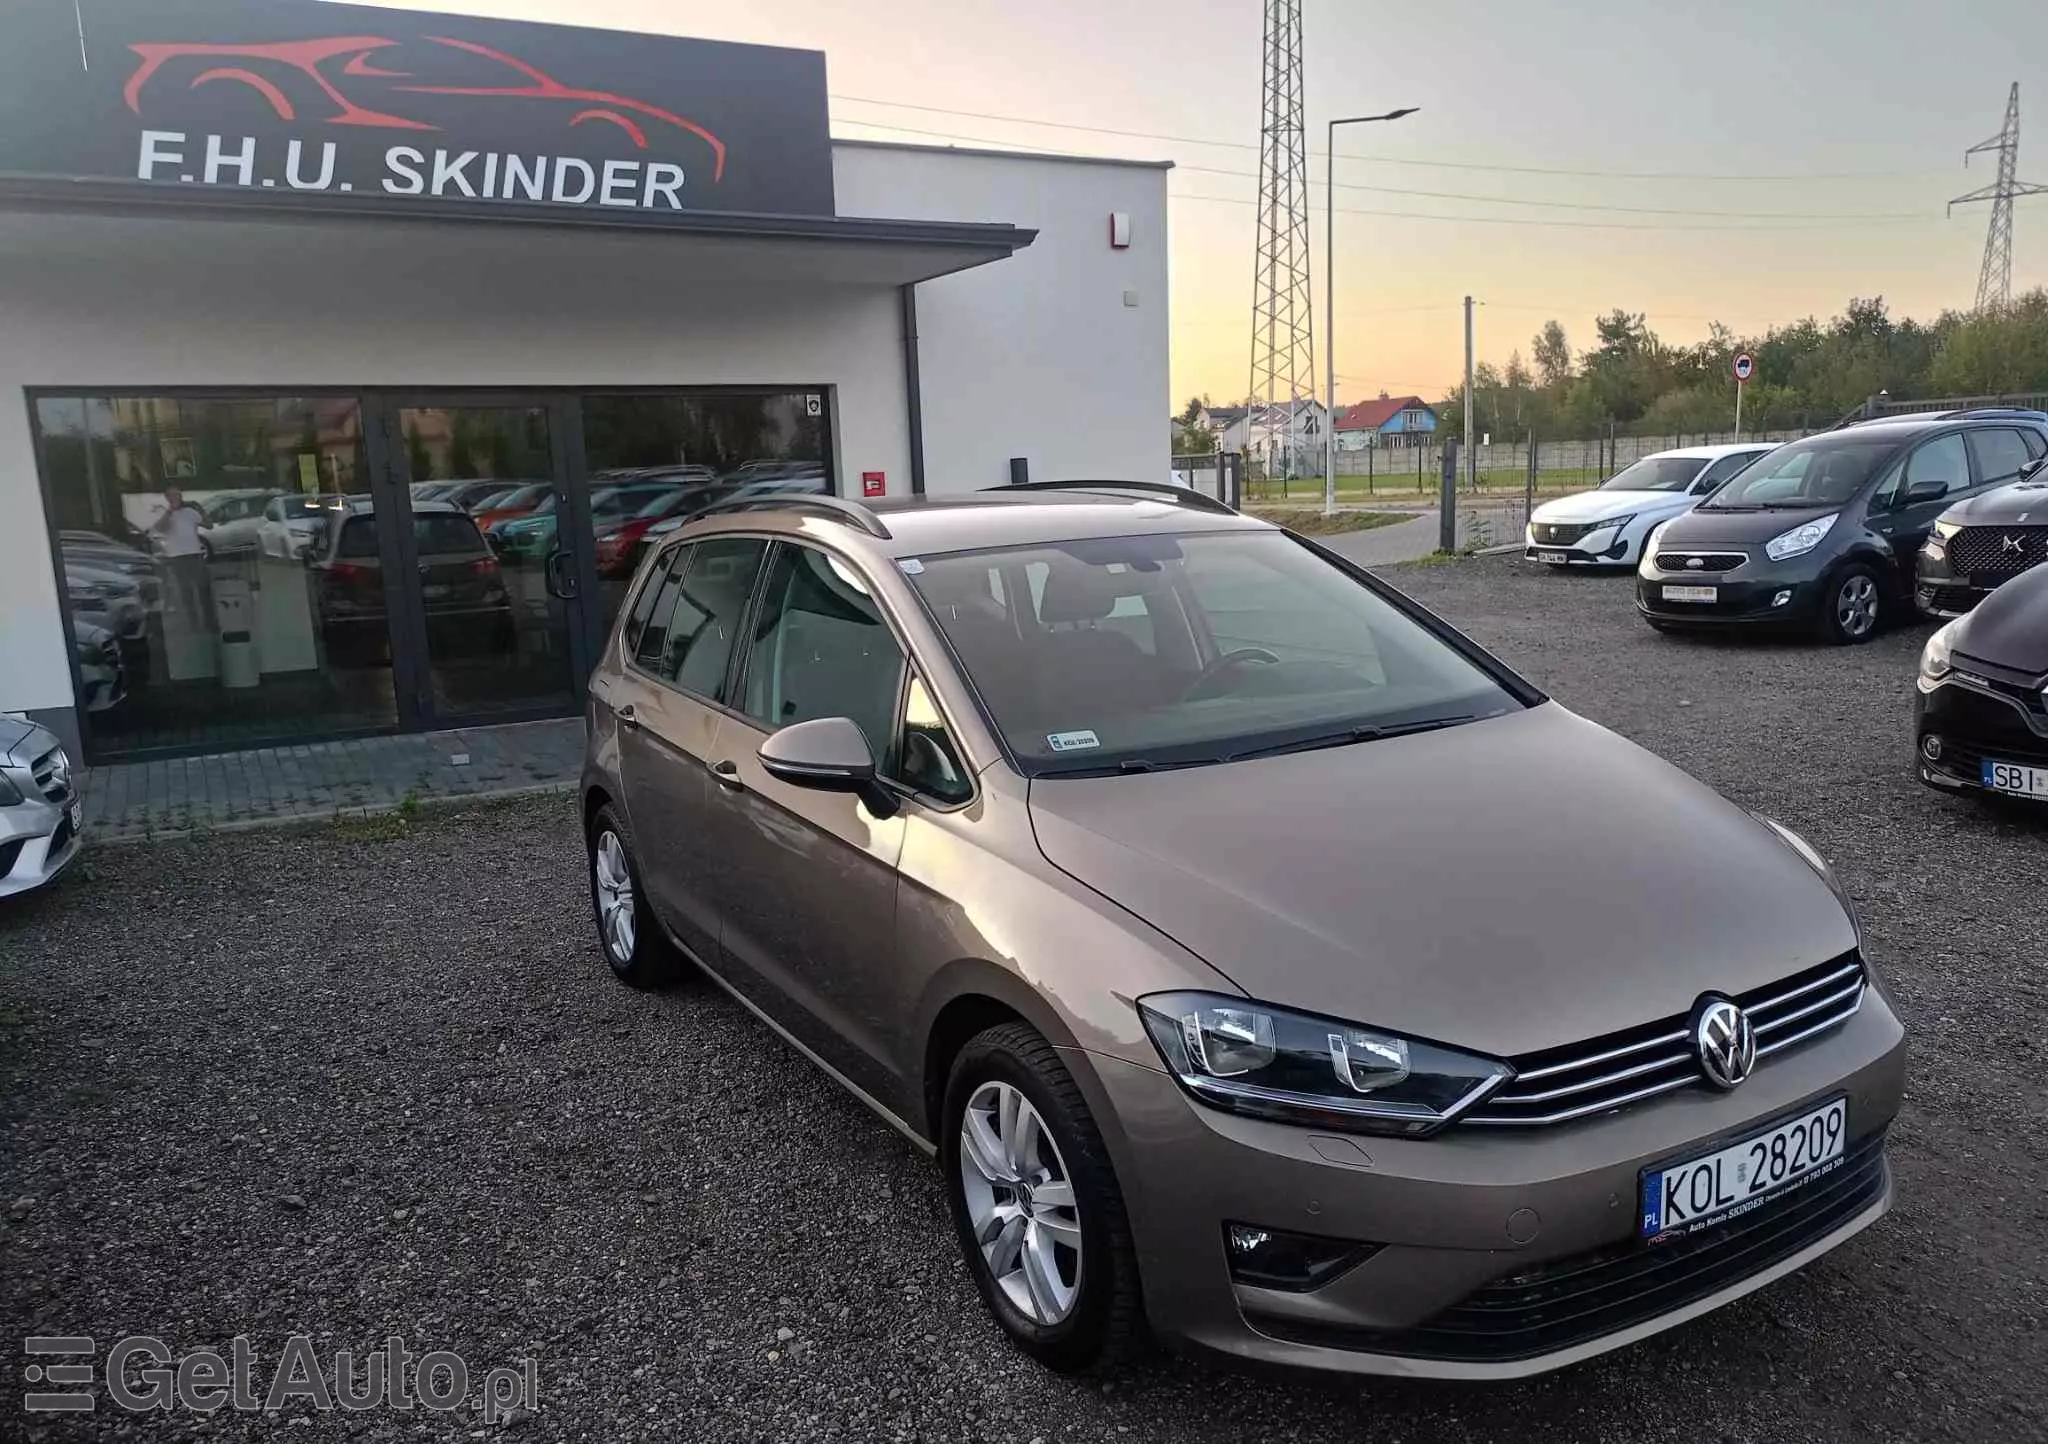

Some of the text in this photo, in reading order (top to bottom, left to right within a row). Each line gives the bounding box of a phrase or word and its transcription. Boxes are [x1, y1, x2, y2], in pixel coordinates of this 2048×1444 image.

[137, 129, 685, 210] F.H.U. SKINDER
[1665, 1107, 1842, 1225] KOL 28209
[1644, 1212, 1658, 1229] PL
